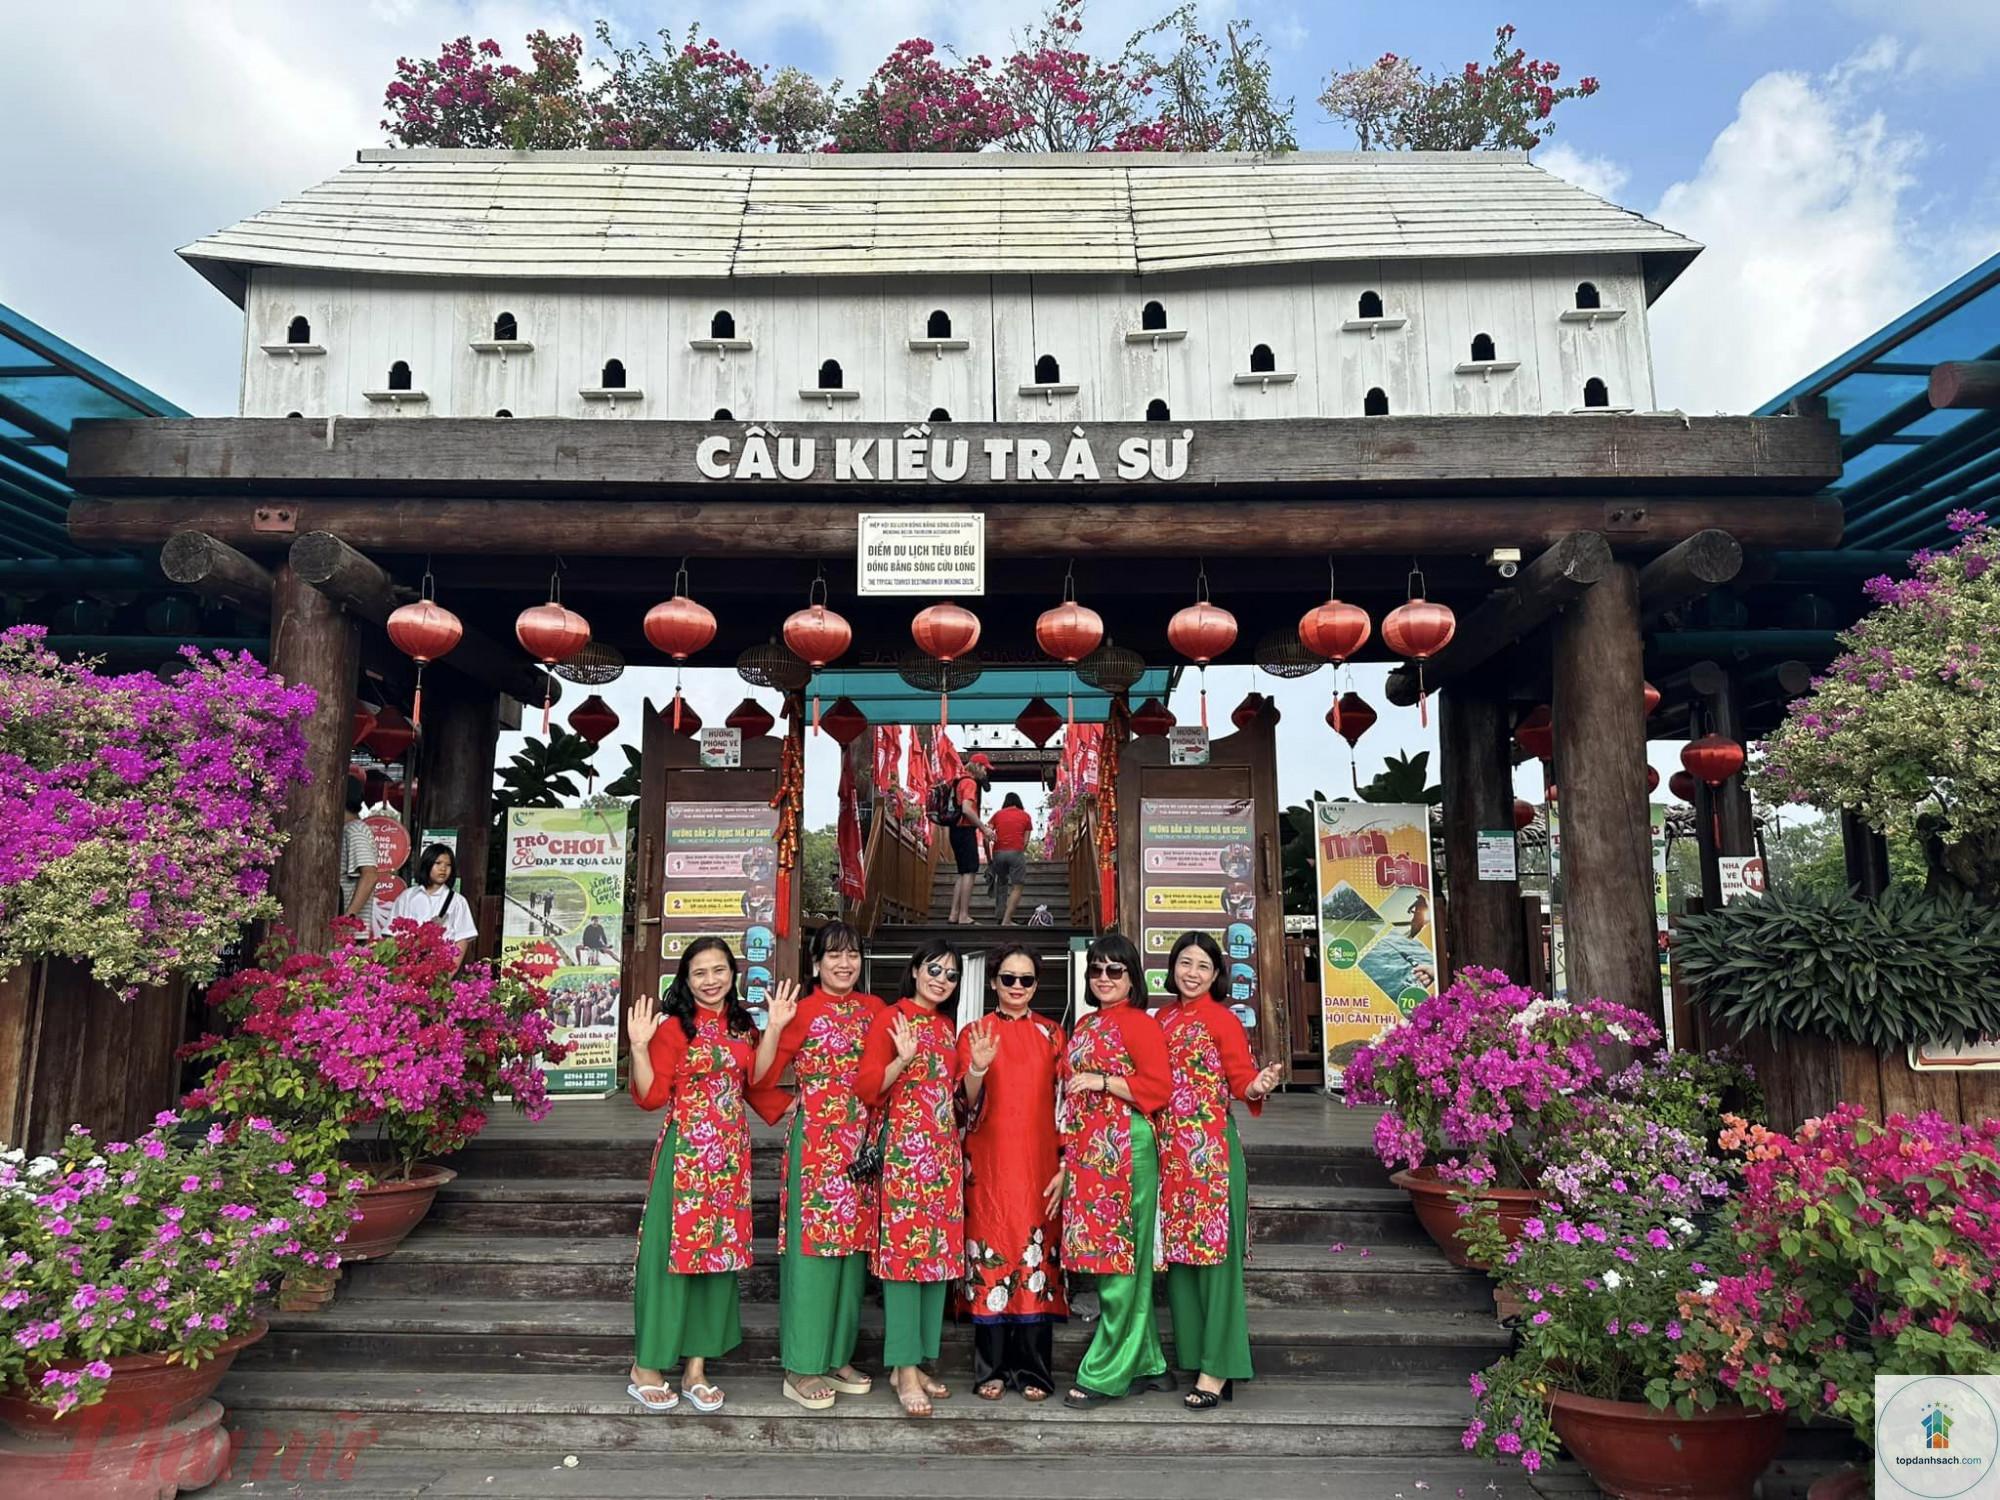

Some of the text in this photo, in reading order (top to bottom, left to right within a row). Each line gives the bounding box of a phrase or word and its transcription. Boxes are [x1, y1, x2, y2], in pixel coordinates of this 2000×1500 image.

[696, 422, 1194, 481] CẦU KIỀU TRÀ SƯ
[955, 562, 976, 572] LONG
[548, 838, 605, 854] CHƠI
[536, 858, 558, 866] ĐẠP
[576, 858, 599, 866] QUA
[1154, 895, 1162, 904] 2
[673, 900, 681, 909] 2
[1324, 997, 1350, 1006] ĐAM
